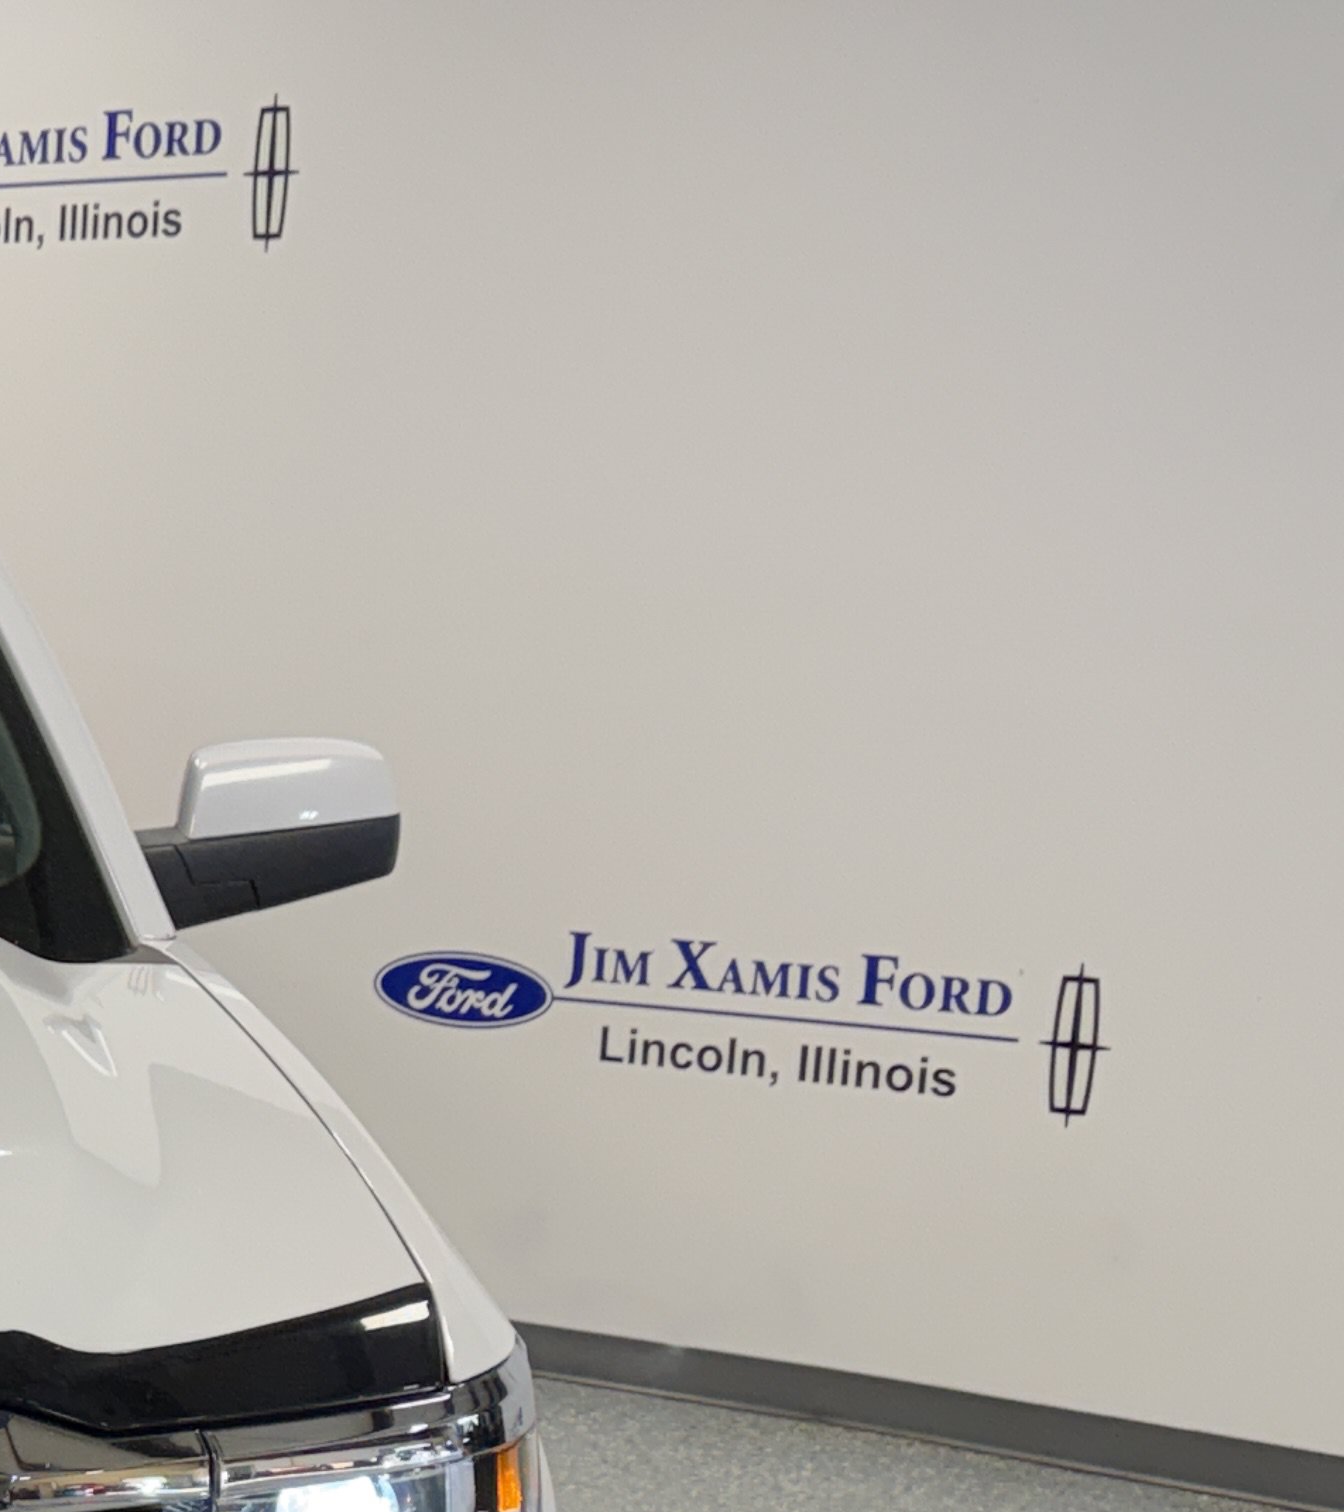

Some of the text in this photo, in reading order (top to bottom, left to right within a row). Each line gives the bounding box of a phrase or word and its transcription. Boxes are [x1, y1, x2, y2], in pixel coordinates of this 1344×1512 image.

[102, 108, 223, 162] FORD
[58, 200, 183, 243] Illinois
[406, 962, 519, 1019] Ford
[562, 930, 1014, 1018] JIM XAMIS FORD
[598, 1024, 957, 1099] Lincoln, Illinois
